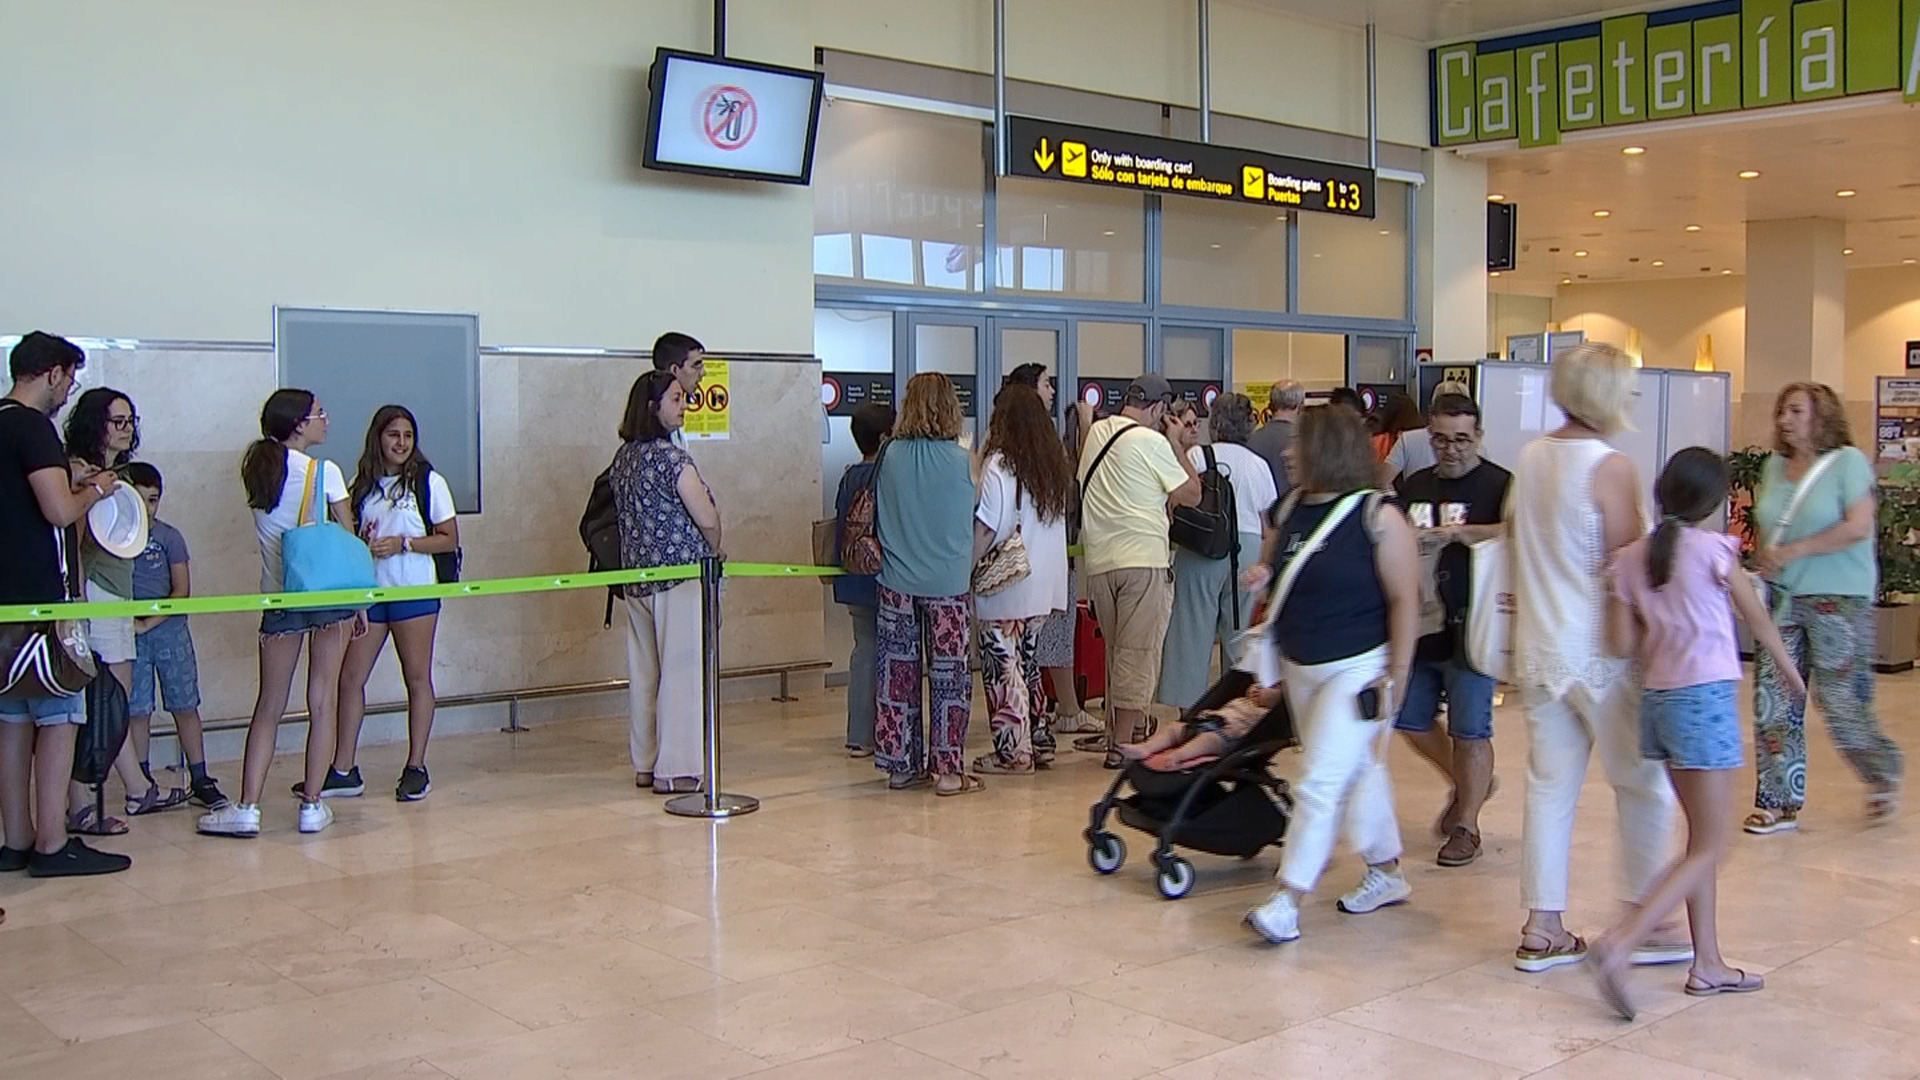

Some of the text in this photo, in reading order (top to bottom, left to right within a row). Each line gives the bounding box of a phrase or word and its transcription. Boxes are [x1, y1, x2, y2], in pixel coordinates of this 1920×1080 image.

[1440, 16, 1836, 140] Cafetería
[1091, 149, 1193, 175] Only with boarding card
[1091, 165, 1232, 195] Sólo con tarjeta de embarque
[1267, 173, 1321, 192] Boarding gates
[1339, 182, 1347, 194] to
[1267, 187, 1301, 204] Puertas
[1326, 180, 1337, 208] 1
[1348, 183, 1360, 211] 3
